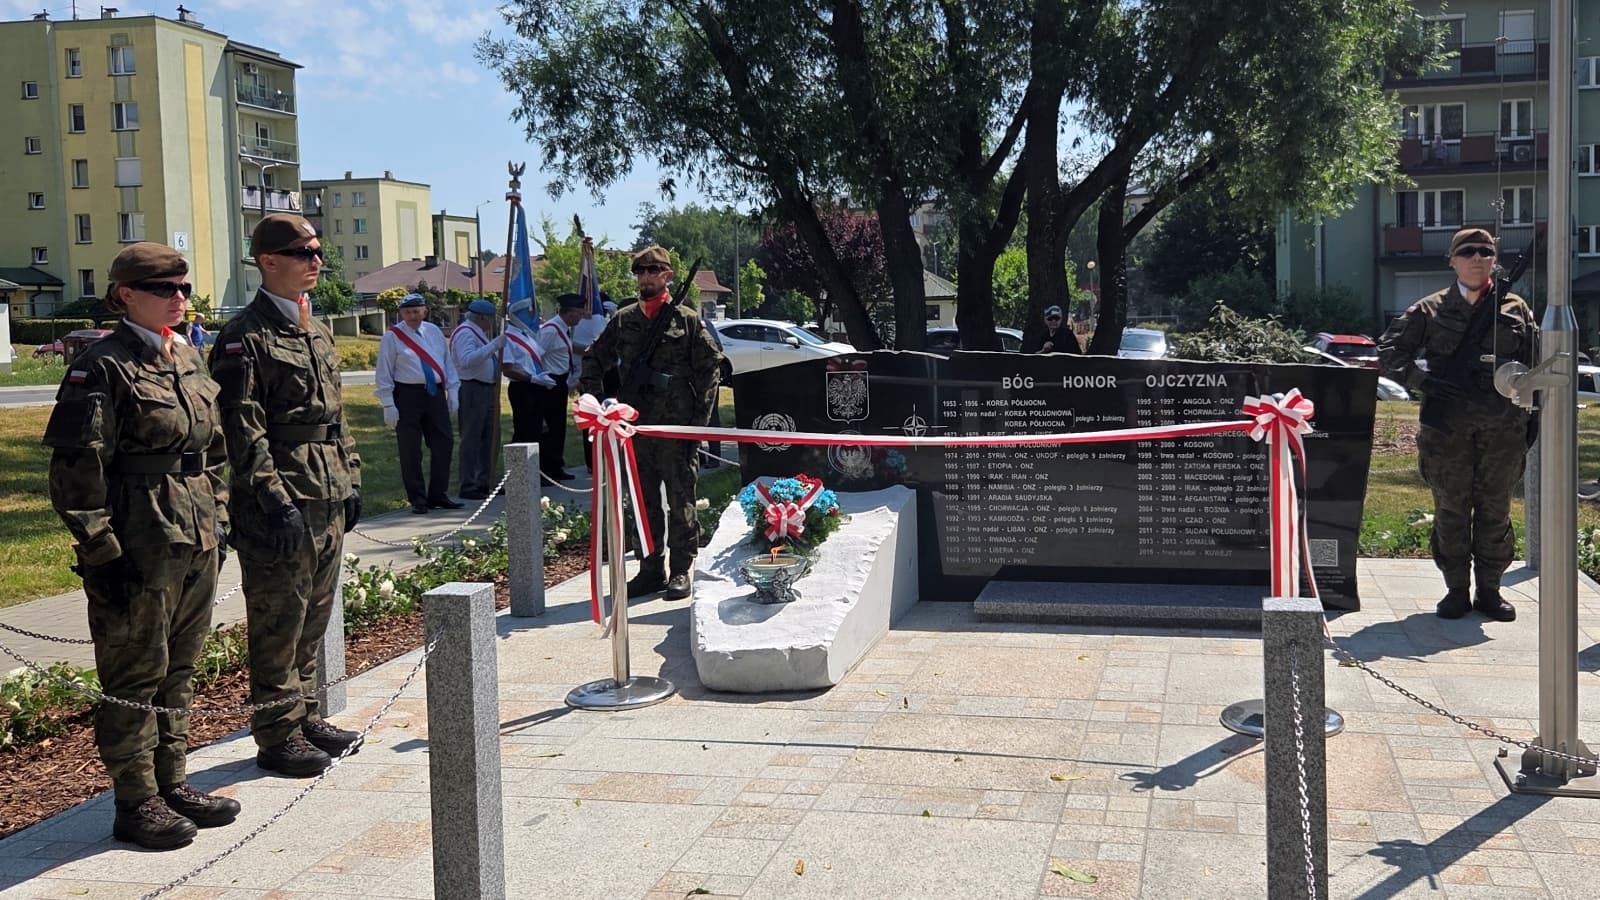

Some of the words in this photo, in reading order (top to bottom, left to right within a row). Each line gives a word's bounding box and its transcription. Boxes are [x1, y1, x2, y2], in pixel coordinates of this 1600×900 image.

[178, 236, 184, 247] 6
[1002, 374, 1034, 389] BÓG
[1063, 375, 1117, 388] HONOR
[1146, 374, 1228, 388] OJCZYZNA
[1011, 398, 1046, 406] PÓŁNOCNA
[1030, 419, 1065, 427] PÓŁNOCNA
